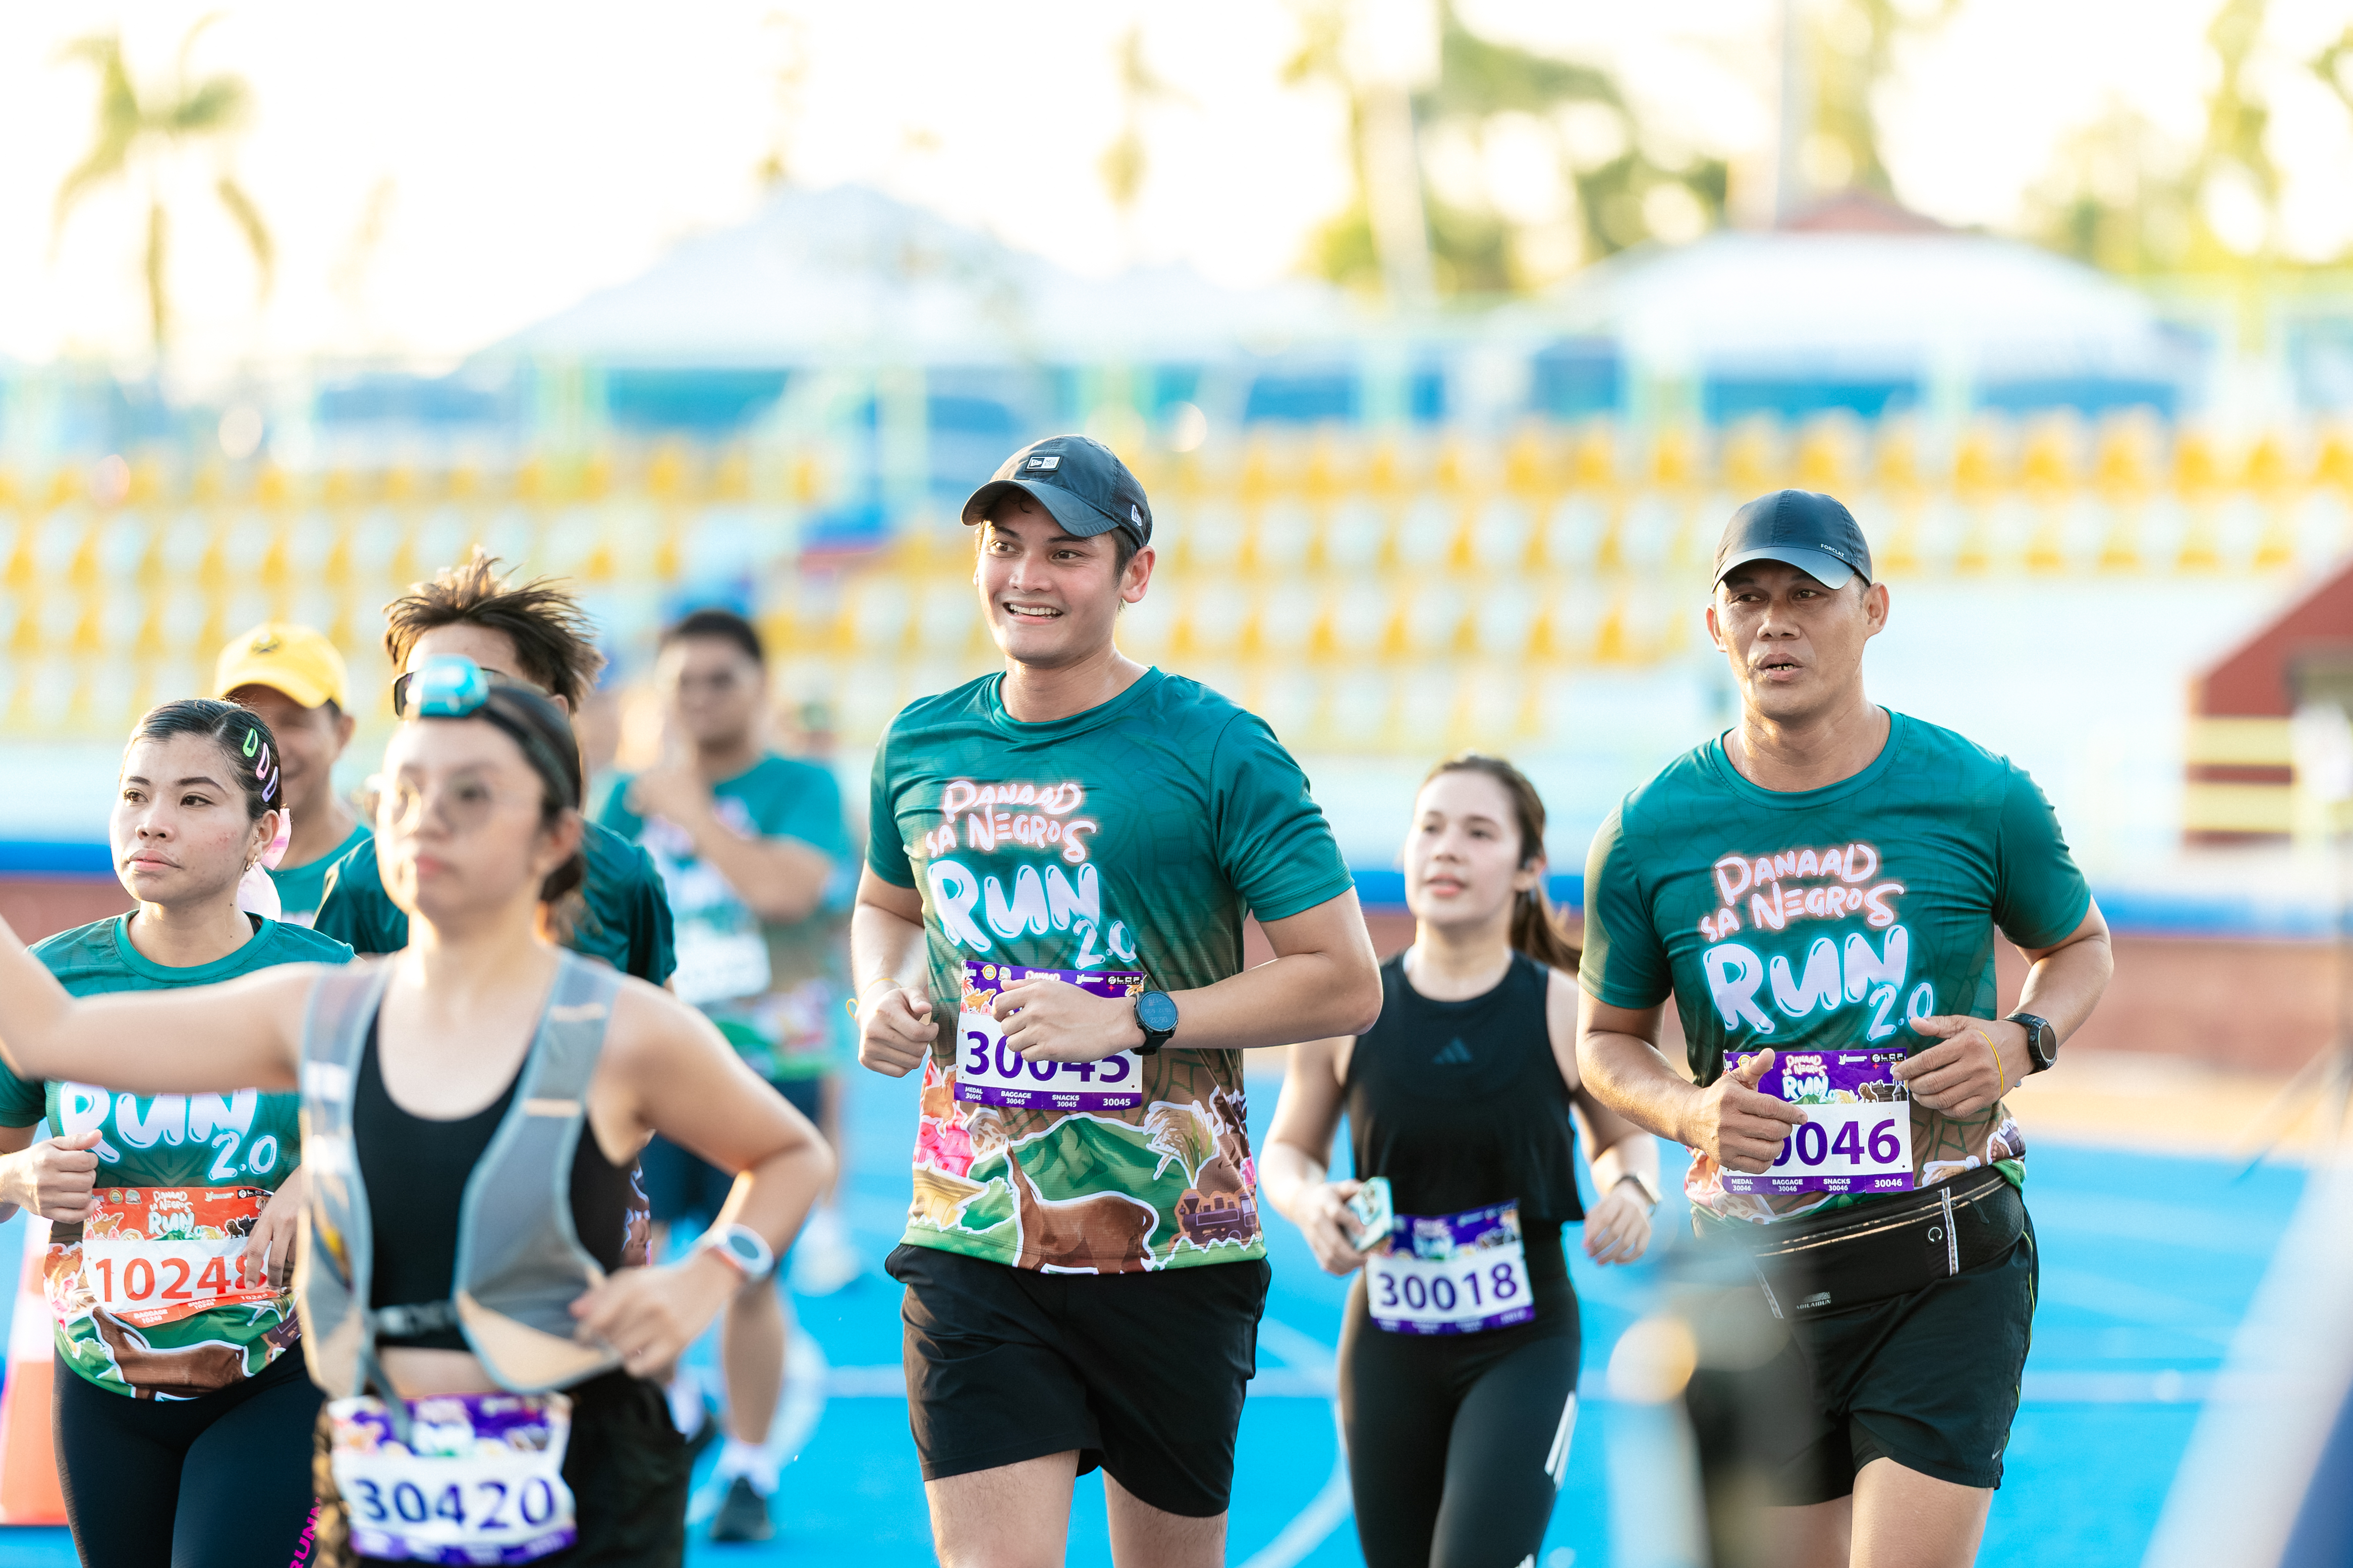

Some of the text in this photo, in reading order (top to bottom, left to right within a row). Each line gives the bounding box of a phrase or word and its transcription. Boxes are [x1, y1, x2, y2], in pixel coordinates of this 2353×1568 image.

[1821, 543, 1844, 558] FORCLAZ
[943, 781, 1082, 823] PANAAD
[926, 804, 1096, 863] SA NEGROS
[1715, 844, 1877, 906] PANAAD
[927, 860, 1100, 952] RUN
[1701, 882, 1904, 942] SA NEGROS
[1073, 918, 1137, 969] 2.0
[1703, 924, 1909, 1034] RUN
[1867, 982, 1933, 1041] 2.0
[1782, 1064, 1827, 1077] SA NEGROS
[1786, 1055, 1822, 1068] PANAAD
[966, 1092, 982, 1100] 30045
[1001, 1090, 1031, 1099] BAGGAGE
[1782, 1076, 1829, 1099] RUN
[61, 1081, 257, 1163] RUN
[209, 1131, 277, 1181] 2.0
[153, 1191, 188, 1203] PANAAD
[1875, 1178, 1902, 1188] 30046
[148, 1211, 195, 1236] RUN
[159, 1200, 194, 1213] NEGROS
[1377, 1263, 1518, 1312] 30018
[133, 1309, 169, 1319] BAGGAGE
[352, 1477, 554, 1531] 30420
